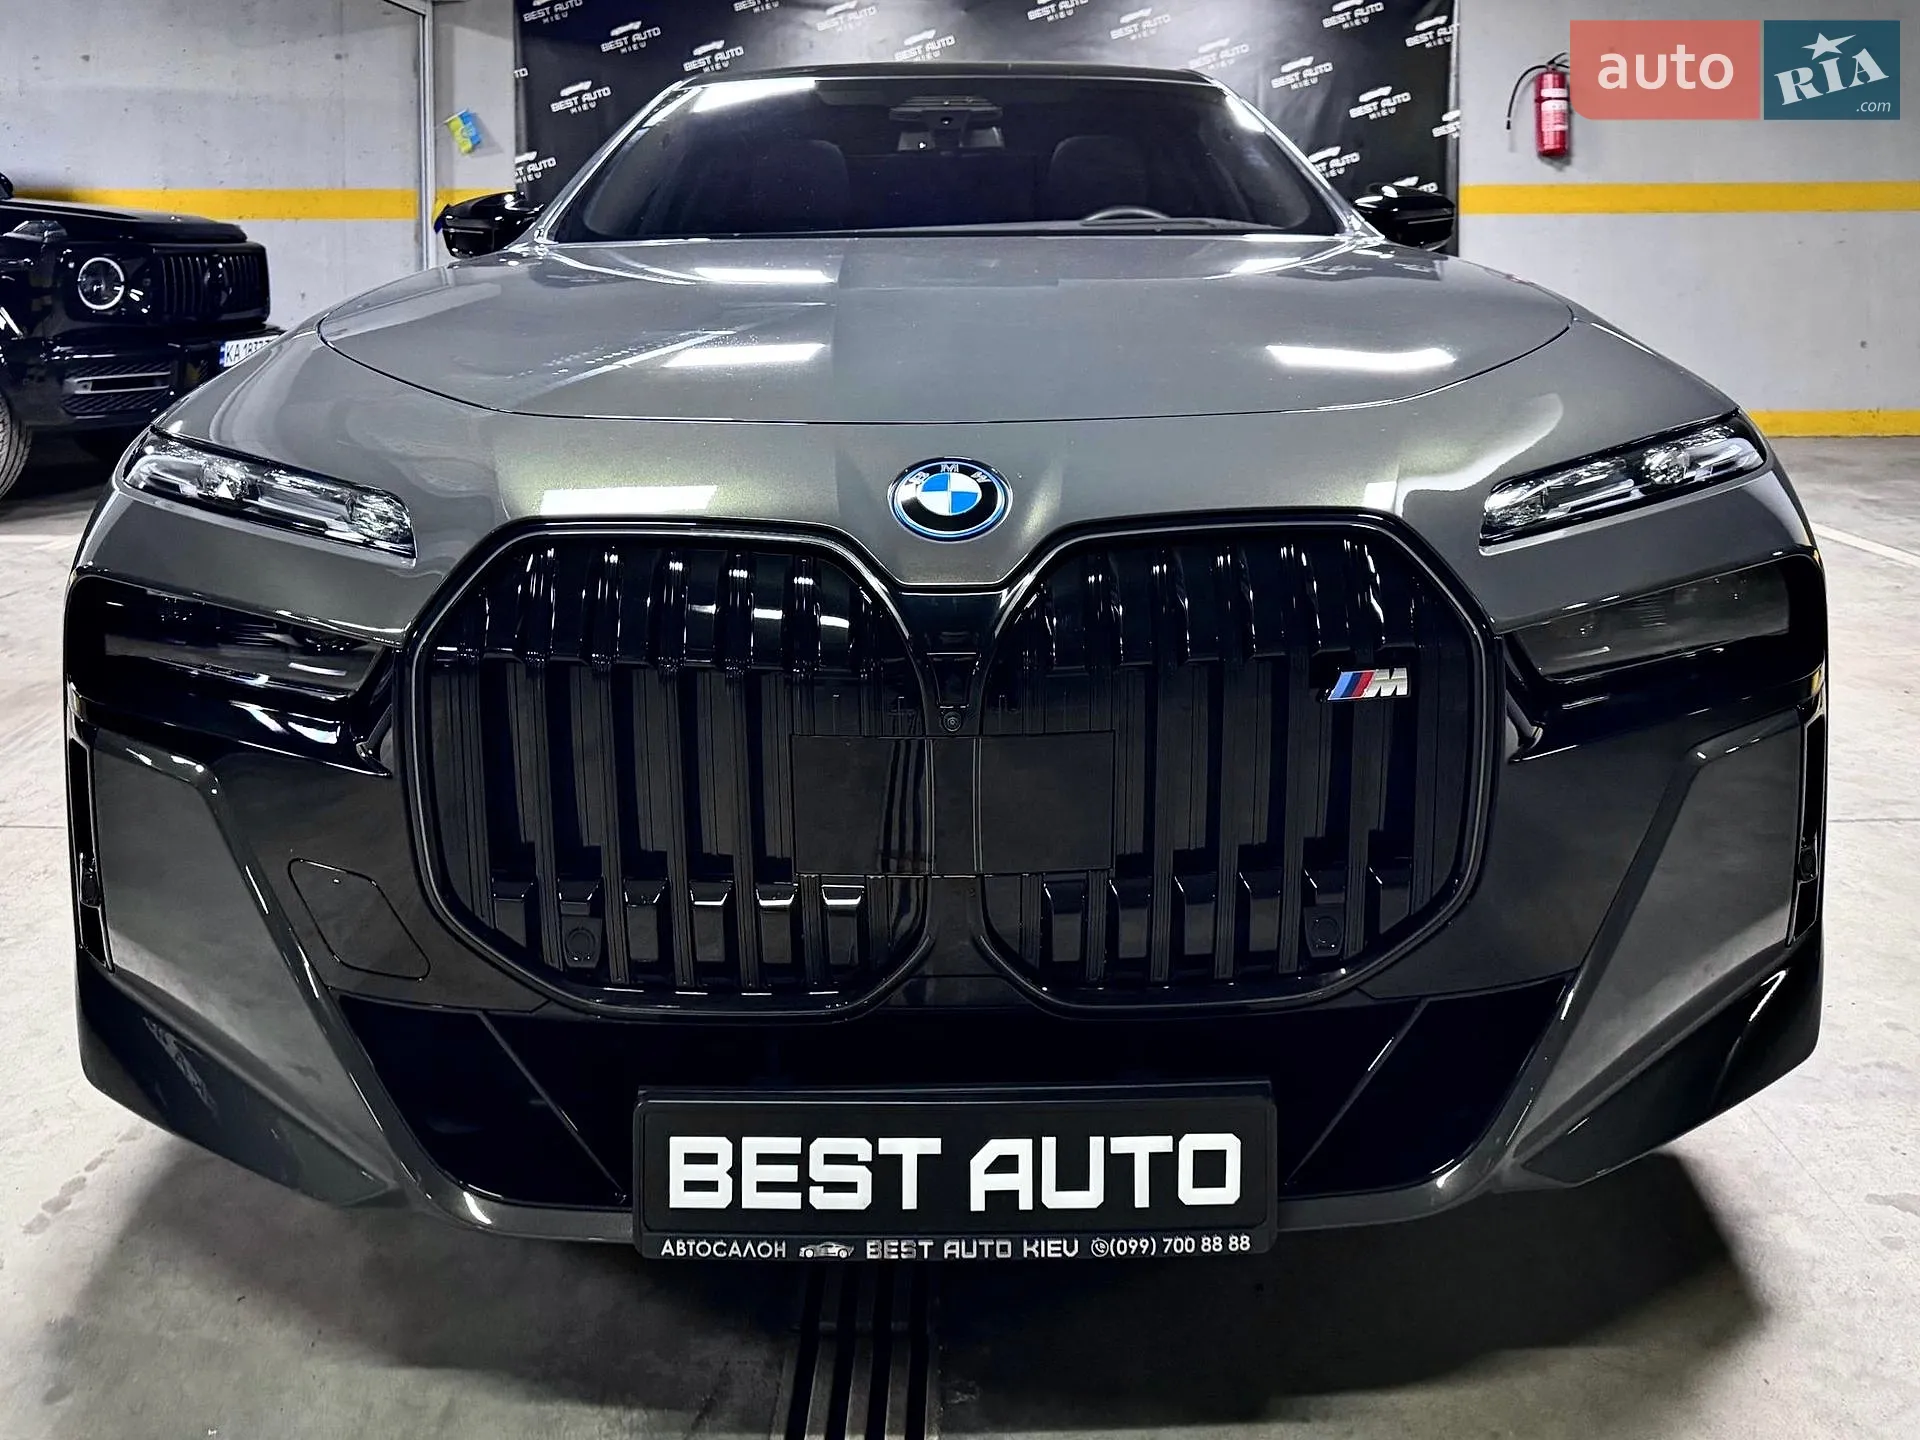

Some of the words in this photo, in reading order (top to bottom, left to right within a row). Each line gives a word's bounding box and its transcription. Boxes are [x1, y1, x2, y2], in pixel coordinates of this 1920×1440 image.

[523, 7, 551, 22] BEST
[1027, 3, 1057, 21] BEST
[1322, 11, 1352, 28] BEST
[1353, 2, 1385, 18] AUTO
[600, 36, 630, 52] BEST
[631, 26, 661, 42] AUTO
[1110, 23, 1140, 40] BEST
[1141, 14, 1172, 29] AUTO
[1405, 30, 1435, 48] BEST
[683, 55, 713, 72] BEST
[714, 46, 745, 62] AUTO
[894, 45, 923, 61] BEST
[925, 35, 956, 51] AUTO
[1219, 44, 1250, 60] AUTO
[1271, 71, 1301, 89] BEST
[1302, 62, 1334, 79] AUTO
[550, 96, 580, 113] BEST
[581, 86, 612, 102] AUTO
[1349, 101, 1379, 118] BEST
[1380, 92, 1412, 108] AUTO
[526, 157, 557, 173] AUTO
[1329, 152, 1361, 169] AUTO
[669, 1136, 942, 1210] BEST
[969, 1133, 1241, 1212] AUTO
[660, 1239, 787, 1259] АВТОСАЛОН
[866, 1239, 934, 1259] BEST
[943, 1239, 1012, 1259] AUTO
[1023, 1239, 1079, 1258] KIEV
[1109, 1237, 1156, 1256] (099)
[1162, 1236, 1195, 1254] 700
[1200, 1236, 1223, 1252] 88
[1228, 1235, 1251, 1251] 88
